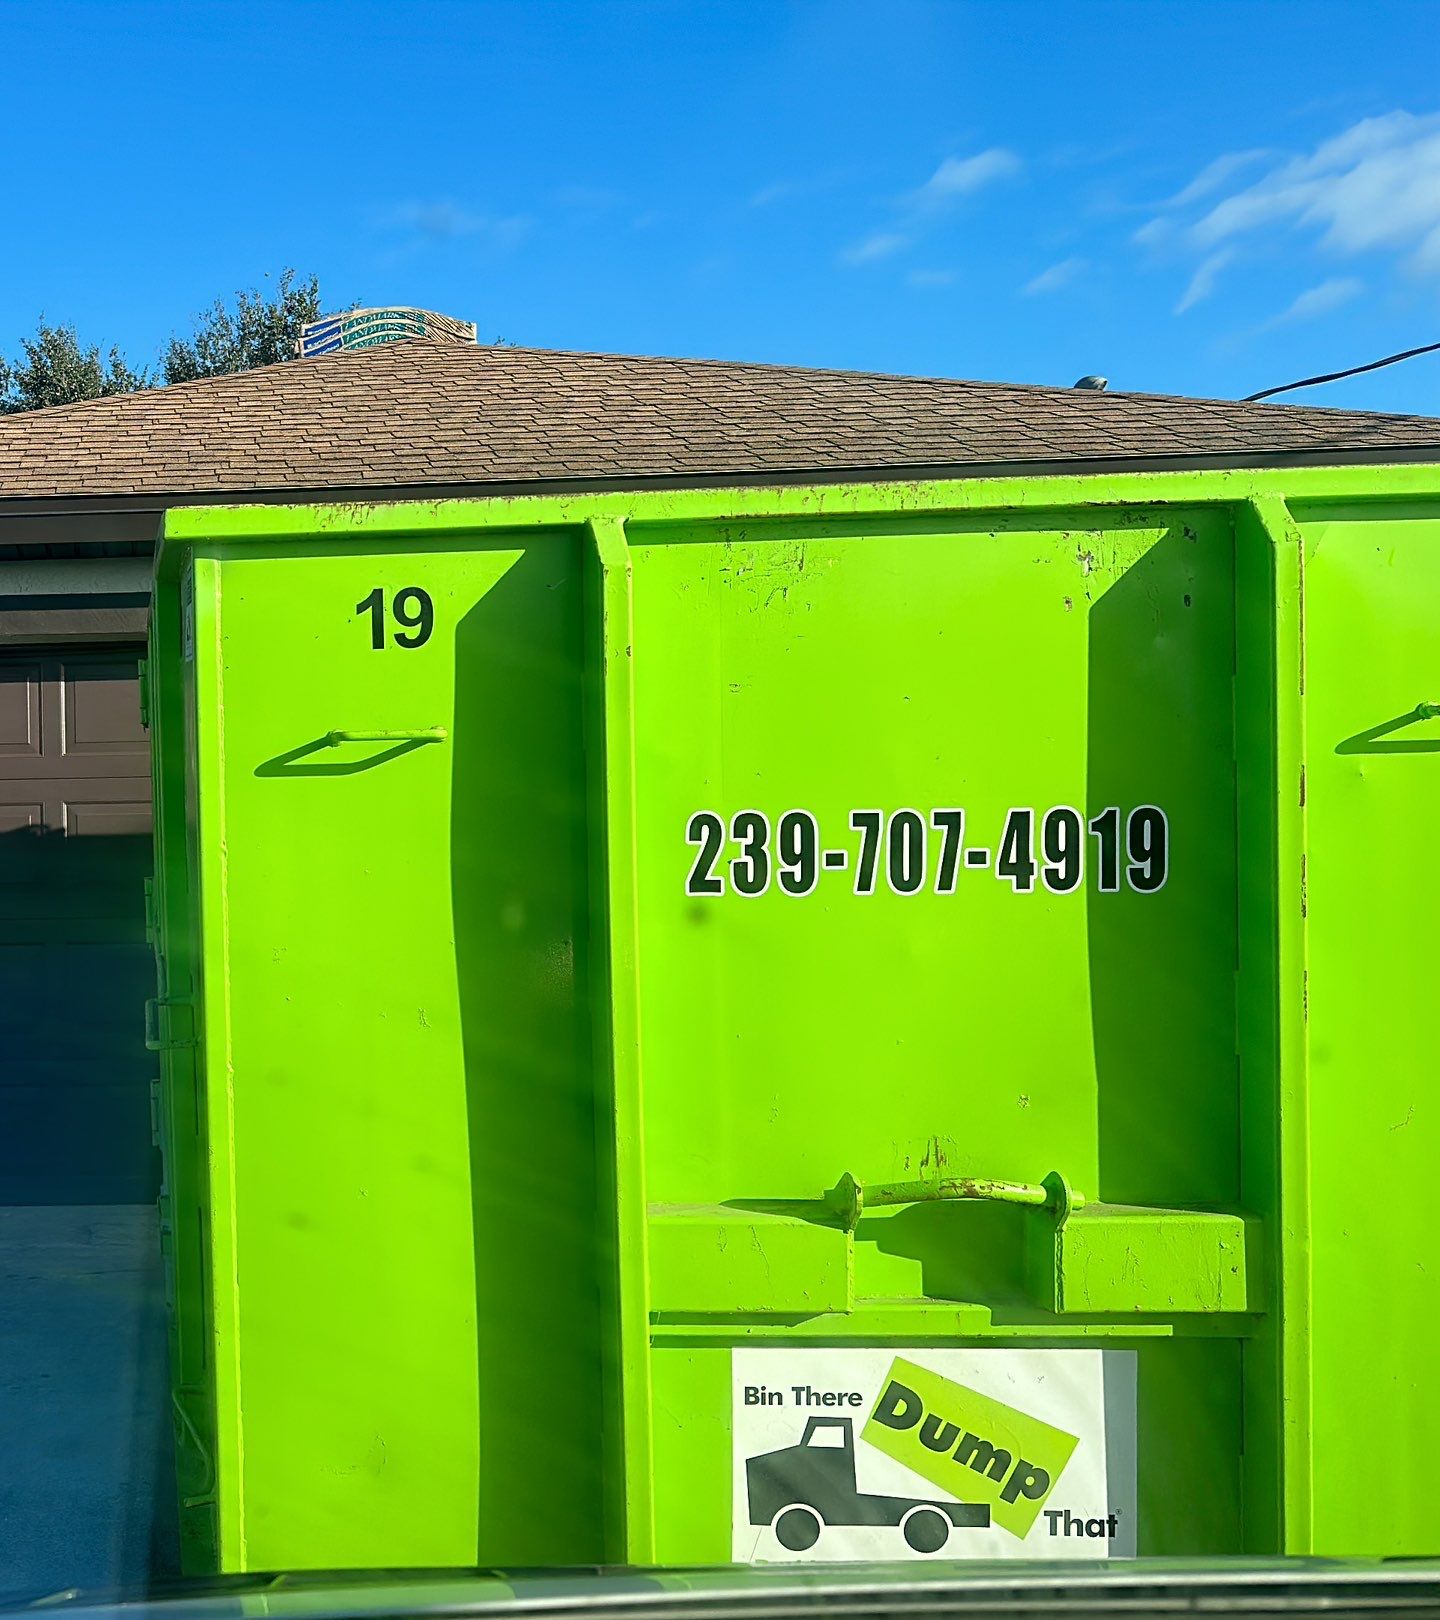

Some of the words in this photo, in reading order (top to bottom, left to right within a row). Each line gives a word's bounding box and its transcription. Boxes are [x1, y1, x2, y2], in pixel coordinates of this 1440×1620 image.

[356, 586, 434, 650] 19
[686, 805, 1169, 896] 239-707-4919
[744, 1386, 783, 1406] Bin
[791, 1386, 863, 1407] There
[872, 1379, 1050, 1504] Dump
[1044, 1509, 1118, 1538] That
